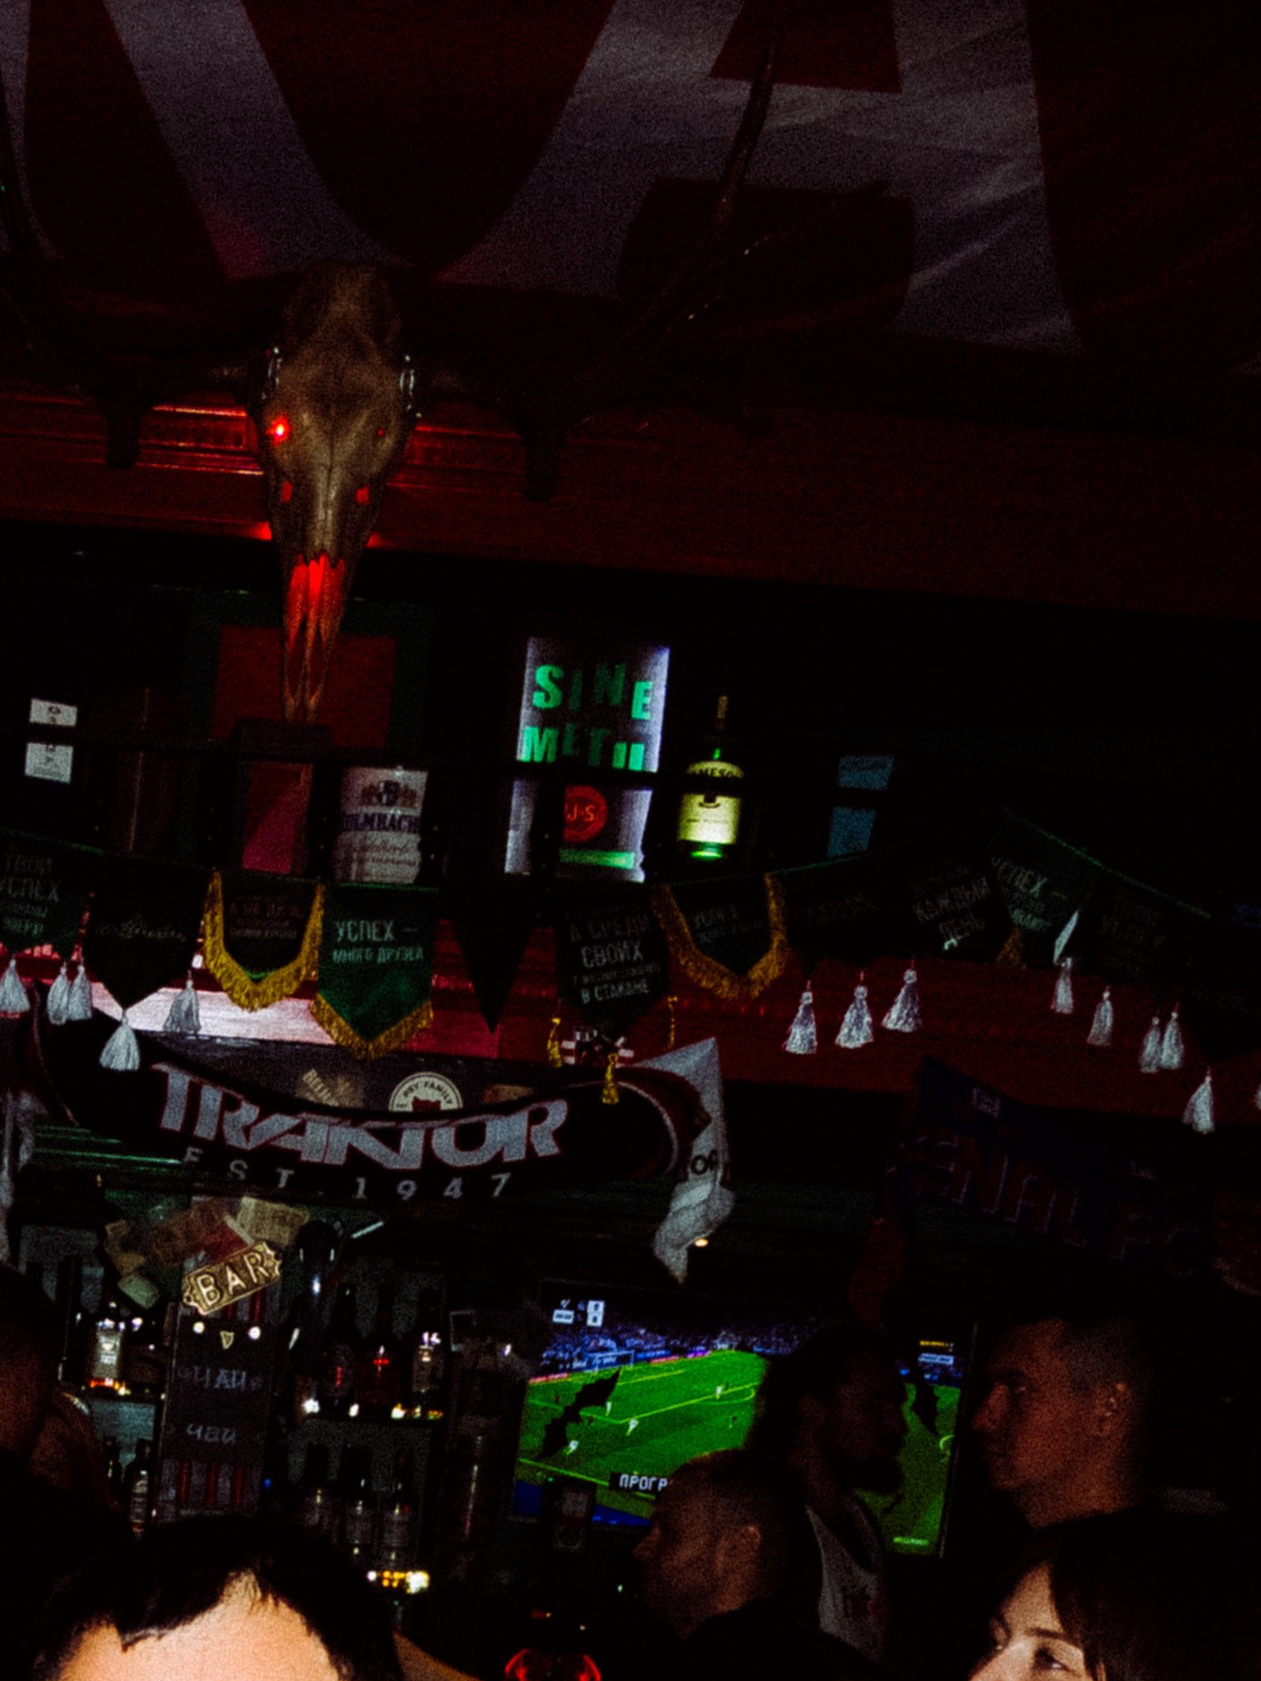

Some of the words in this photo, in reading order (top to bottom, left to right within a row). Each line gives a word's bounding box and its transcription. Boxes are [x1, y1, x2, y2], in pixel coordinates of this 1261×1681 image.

[531, 662, 653, 722] SINE
[334, 918, 396, 943] УСПЕХ
[580, 938, 645, 969] СВОИХ
[423, 1080, 454, 1105] FAMILY
[351, 1171, 513, 1204] 1947
[195, 1250, 270, 1307] BAR
